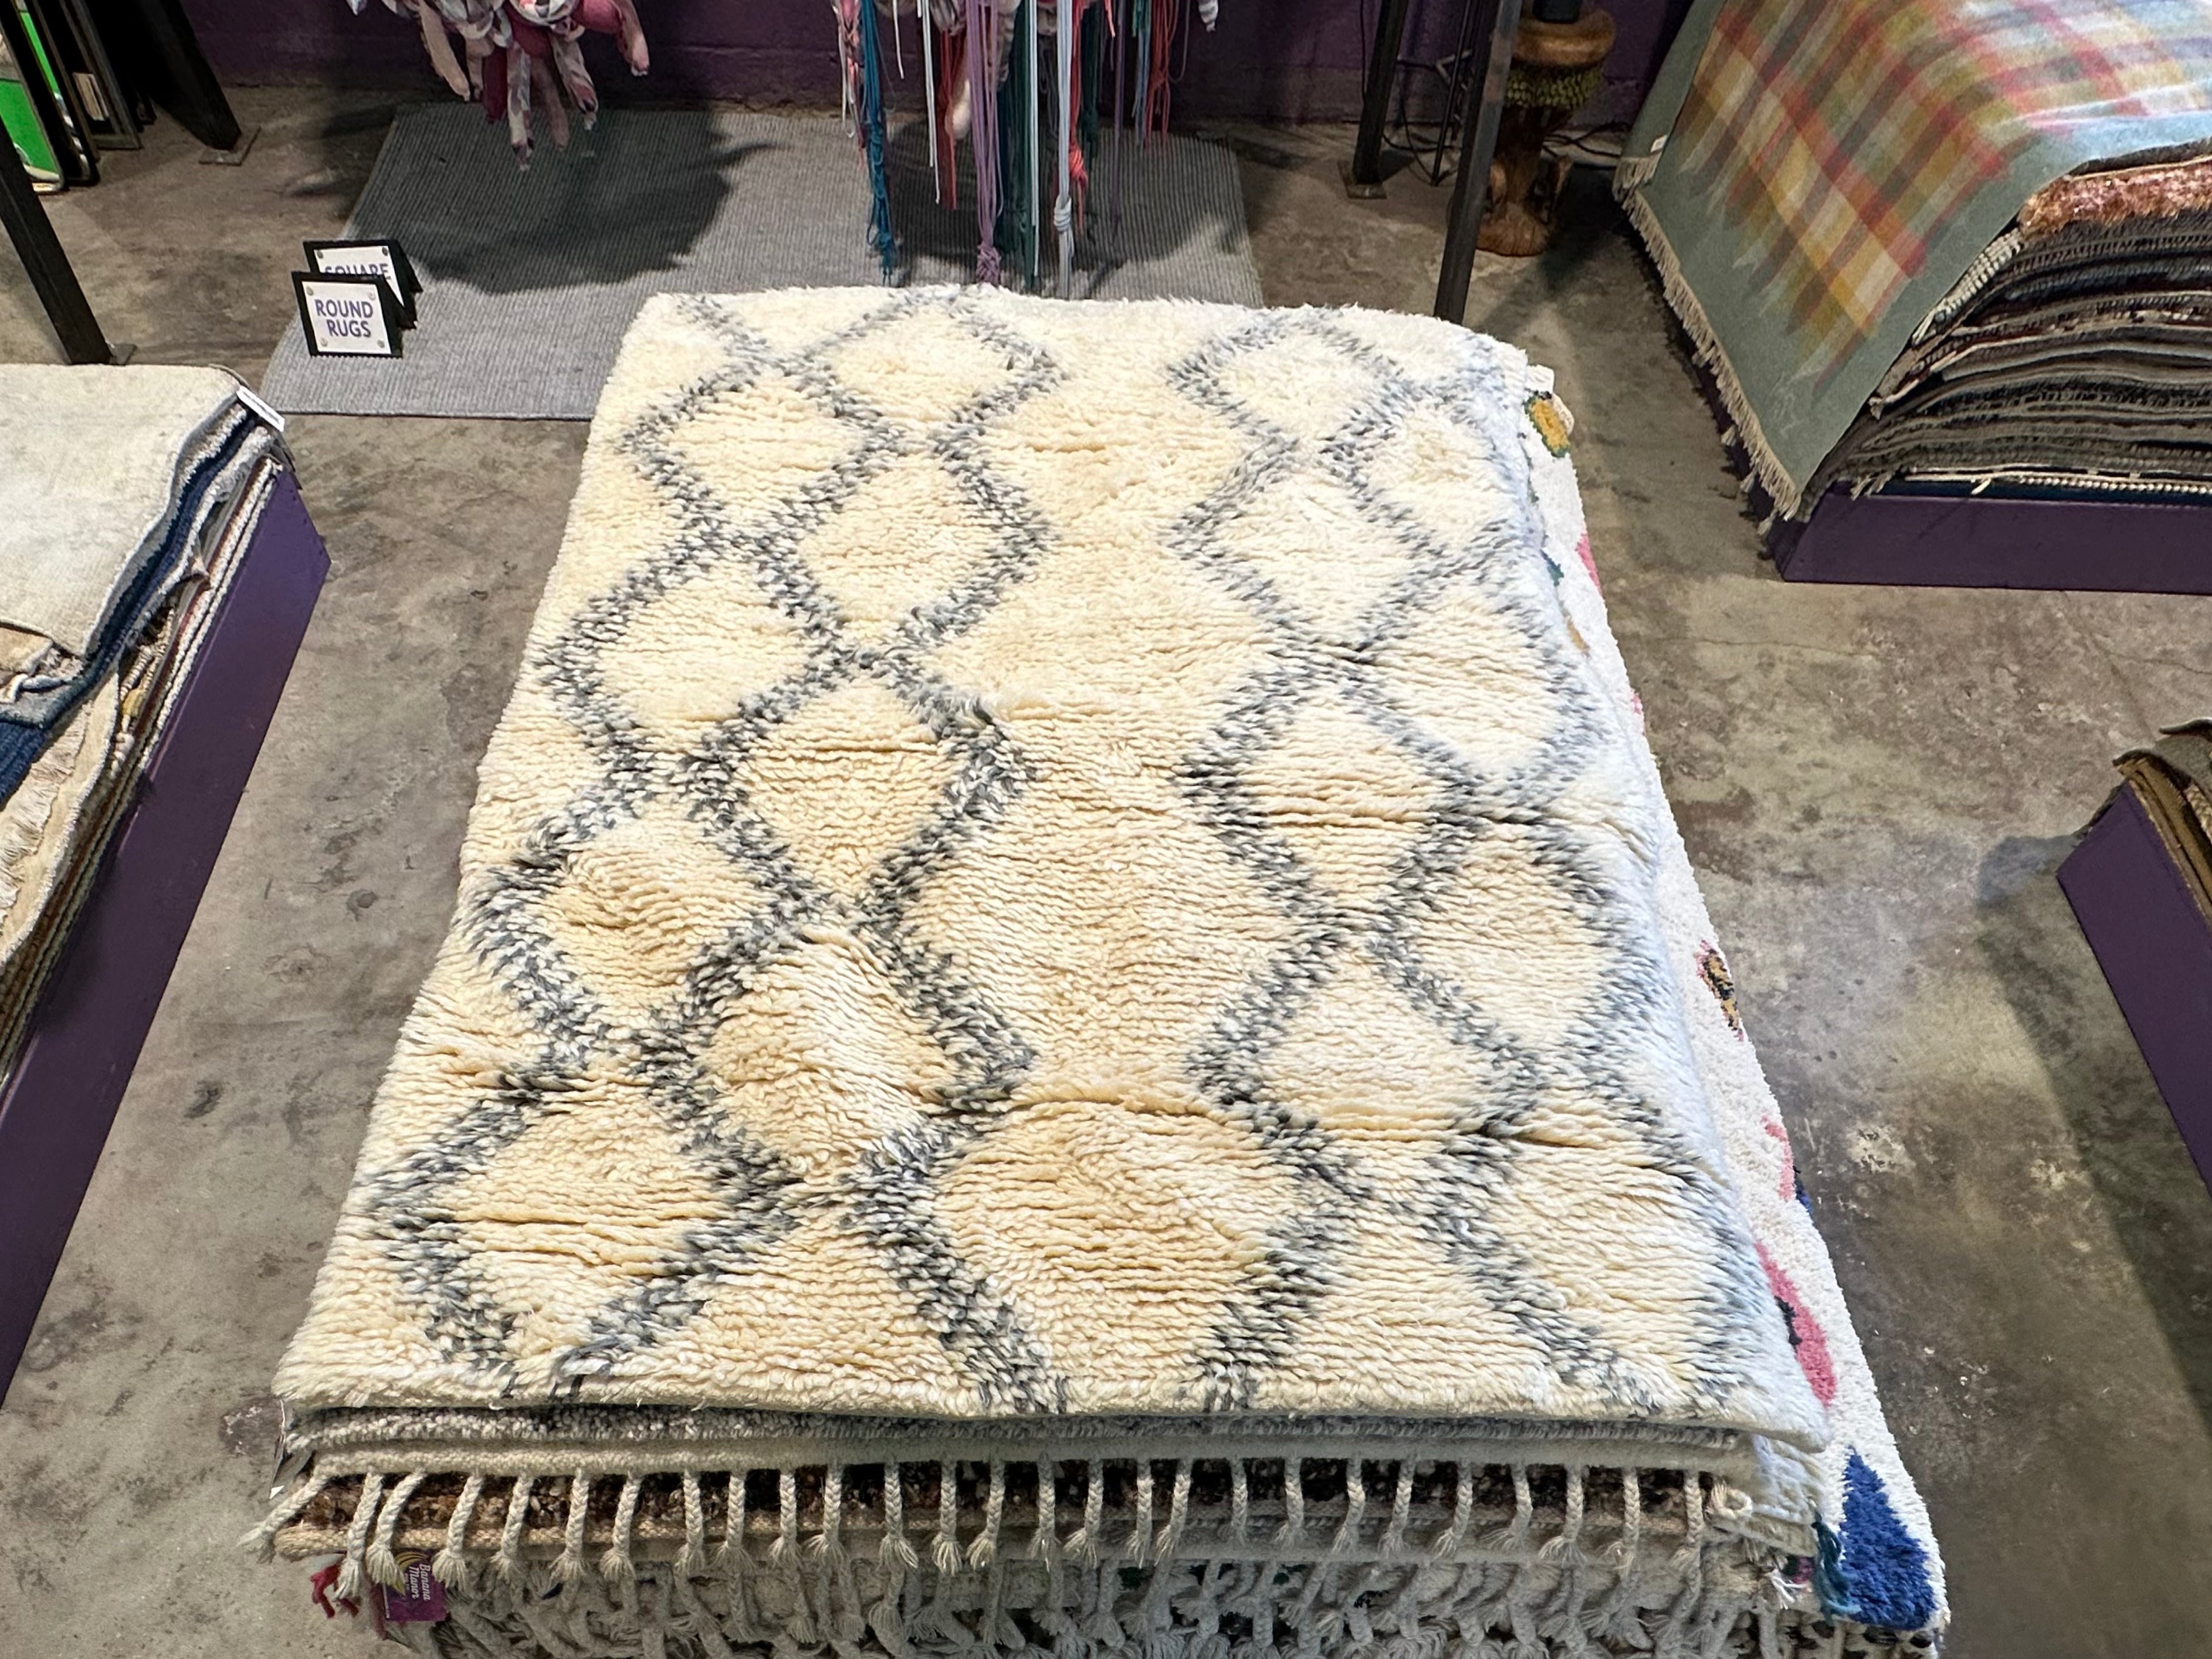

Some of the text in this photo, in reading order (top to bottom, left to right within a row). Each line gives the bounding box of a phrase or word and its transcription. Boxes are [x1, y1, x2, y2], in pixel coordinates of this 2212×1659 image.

[314, 299, 374, 318] ROUND
[326, 320, 371, 337] RUGS
[408, 1566, 420, 1599] Manor
[419, 1563, 431, 1601] Banana
